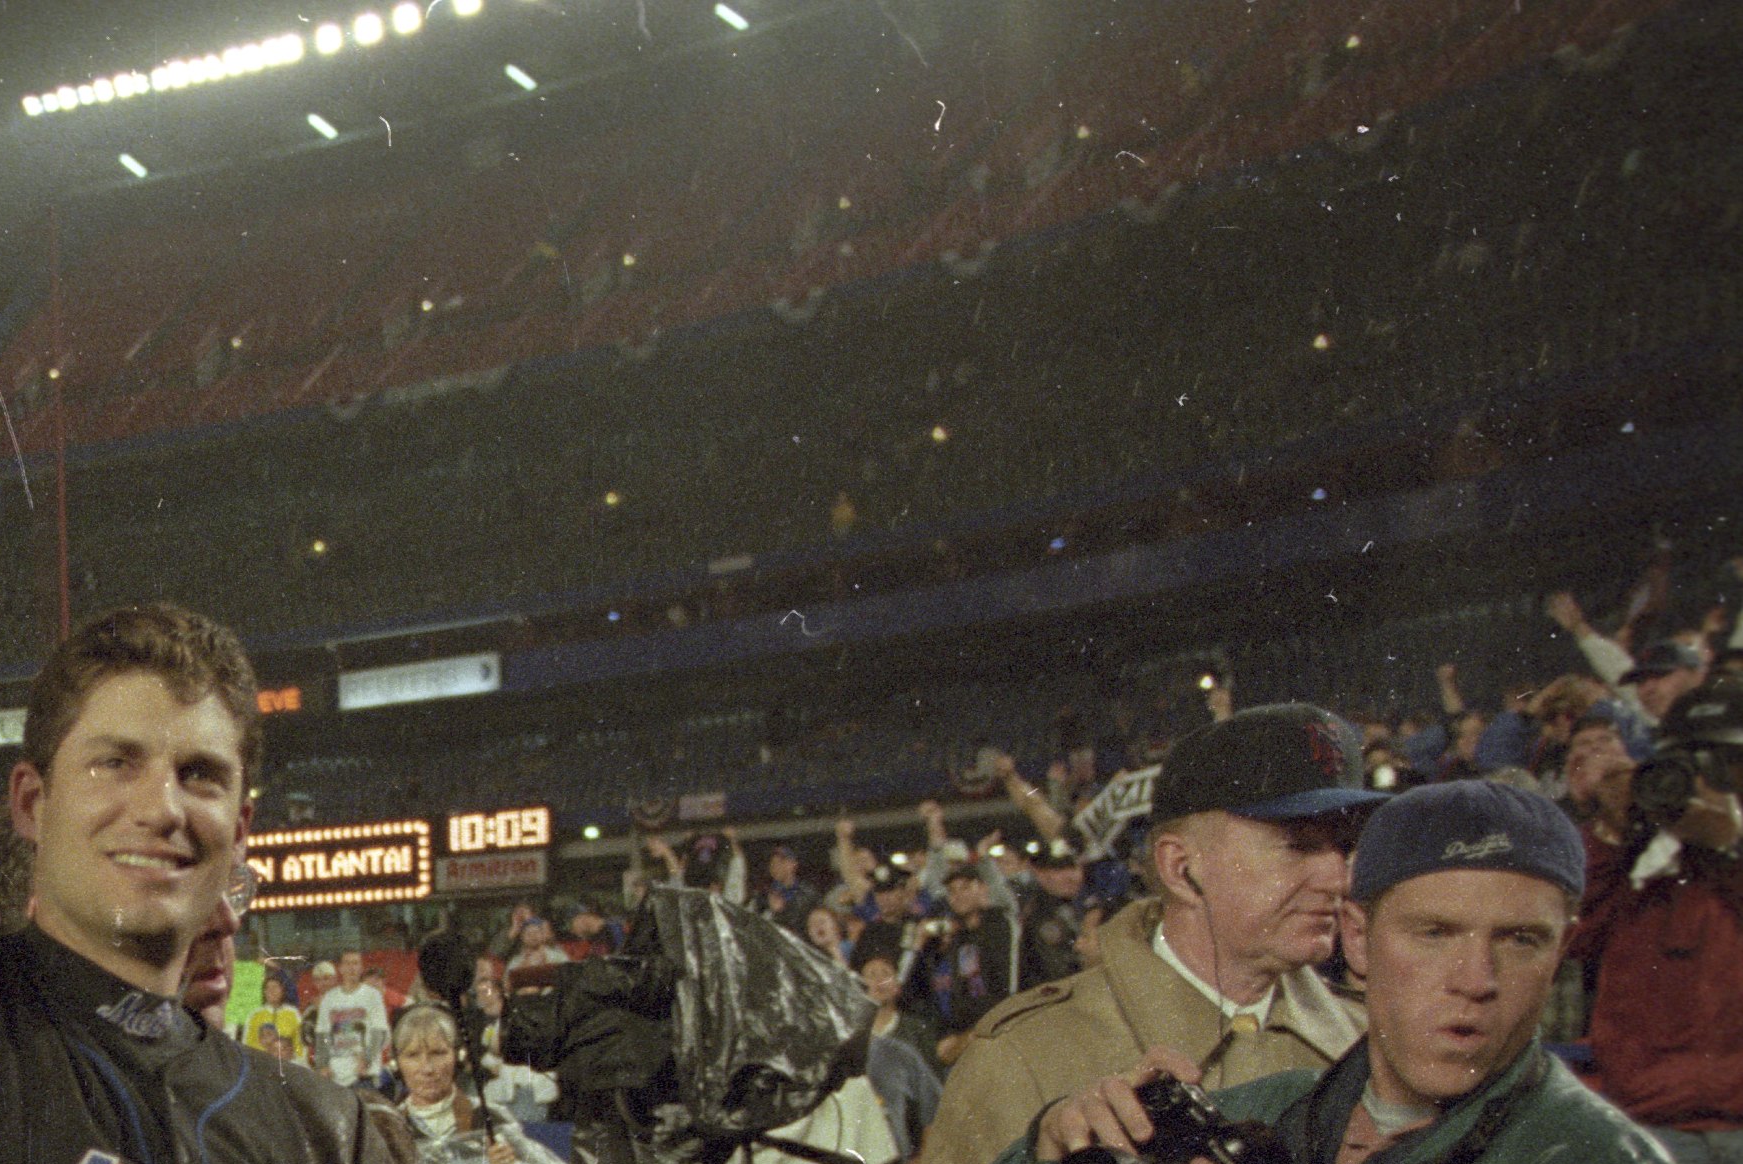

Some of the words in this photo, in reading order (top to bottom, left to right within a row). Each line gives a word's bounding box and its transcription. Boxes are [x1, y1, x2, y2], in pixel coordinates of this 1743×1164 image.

[448, 807, 549, 852] 10:09
[248, 858, 274, 882] N
[282, 845, 413, 882] ATLANTA!
